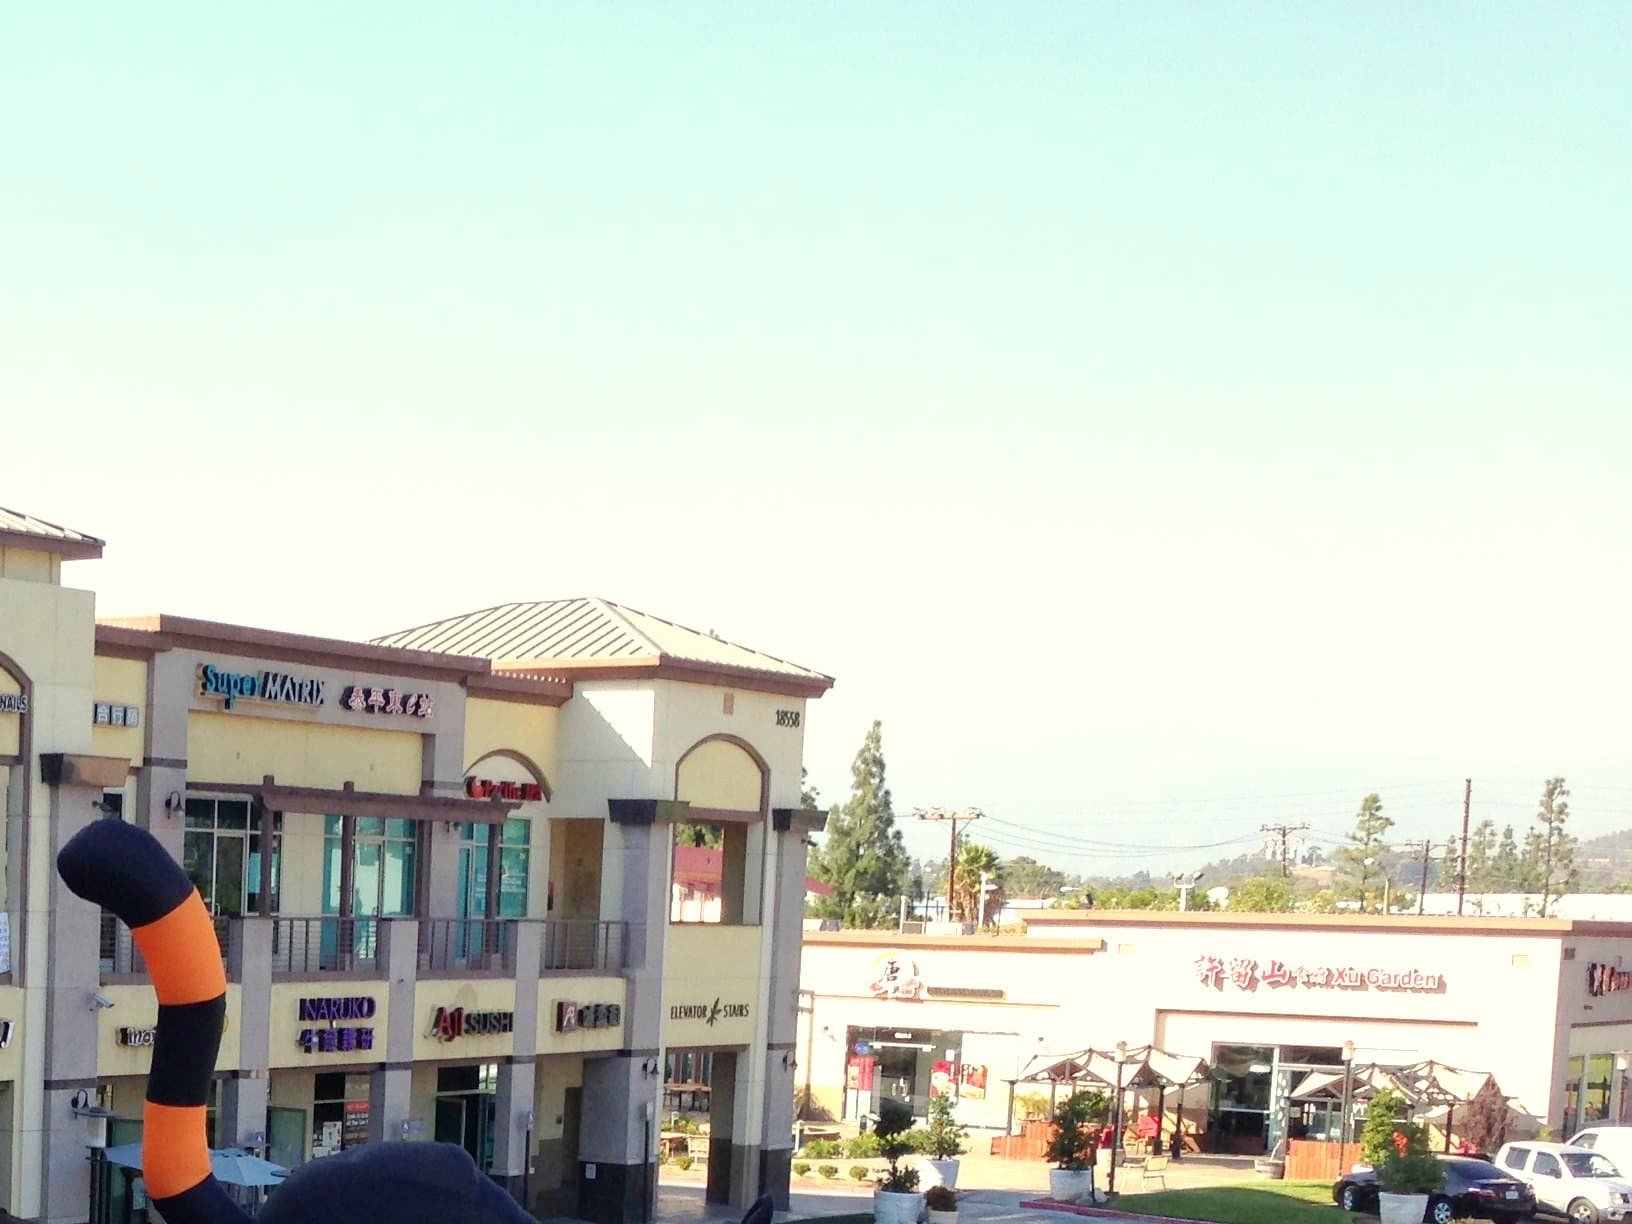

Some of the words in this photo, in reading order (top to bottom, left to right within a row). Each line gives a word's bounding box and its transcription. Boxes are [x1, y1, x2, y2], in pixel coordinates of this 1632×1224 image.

[205, 663, 262, 705] Super
[265, 671, 325, 705] MATRIX
[1366, 967, 1441, 989] Garden
[303, 997, 372, 1020] NARUKO
[670, 1005, 708, 1020] ELEVATOR
[723, 1003, 750, 1019] STAIRS
[469, 1012, 514, 1034] SUSH
